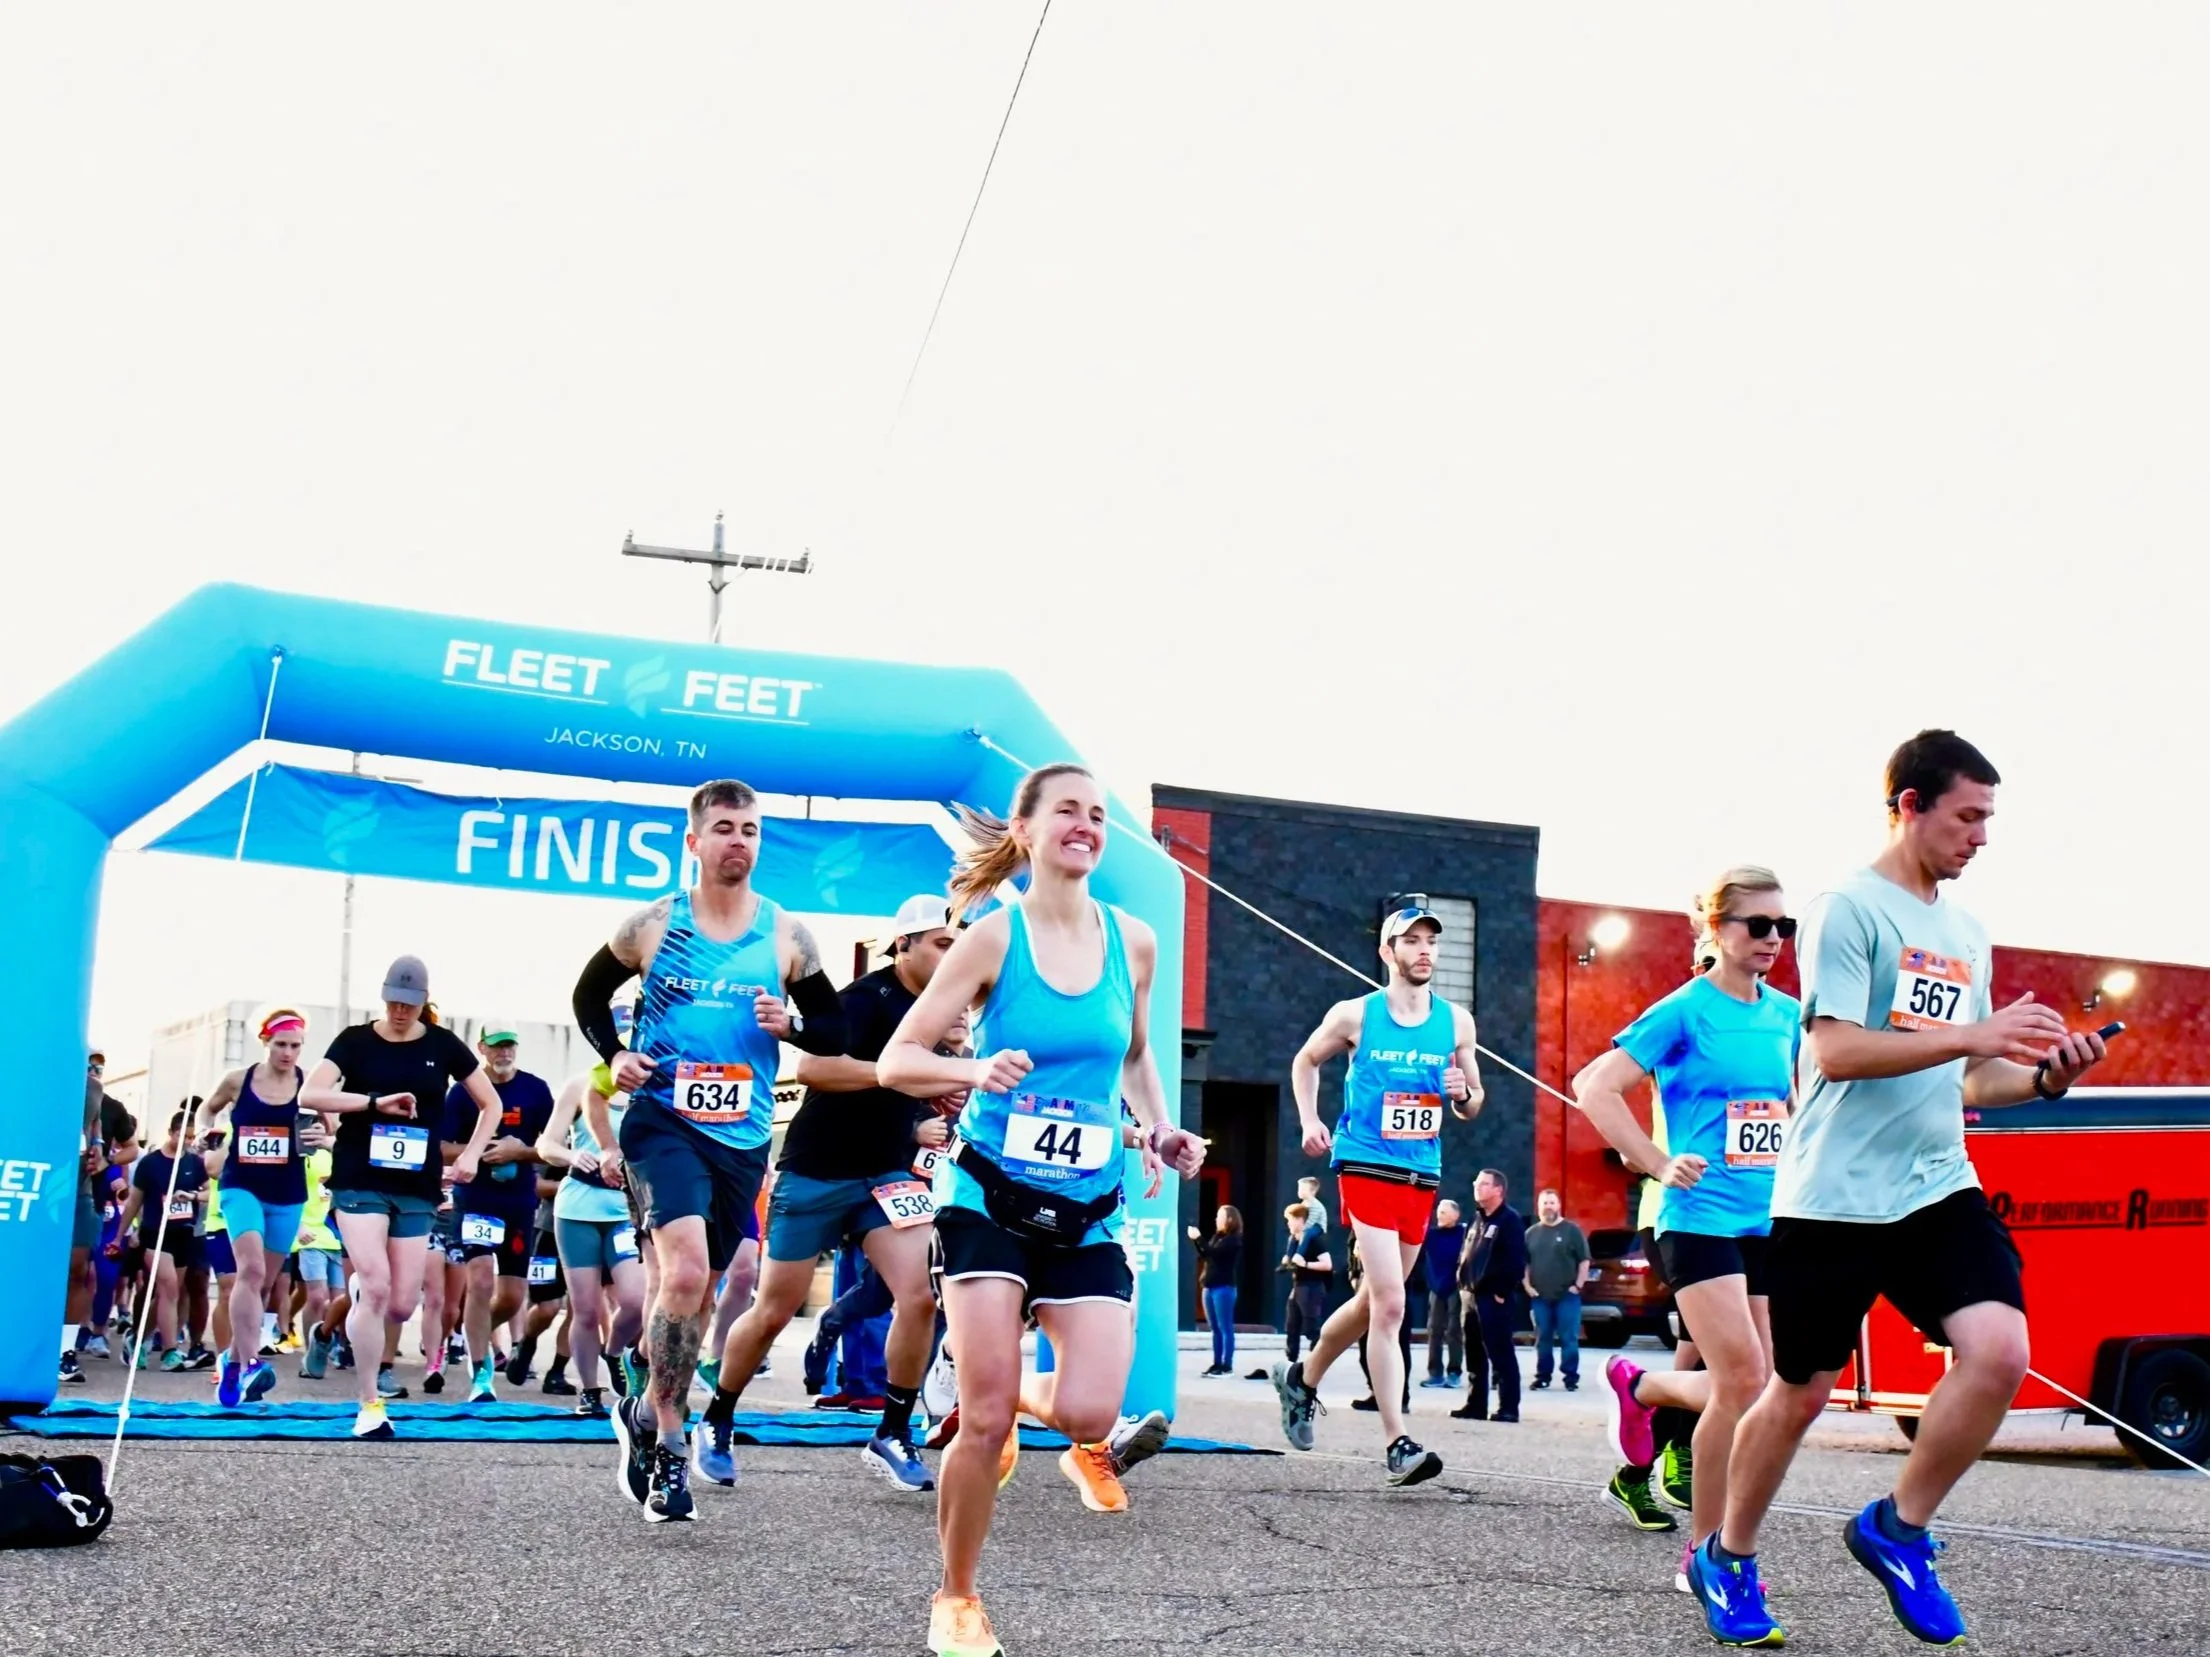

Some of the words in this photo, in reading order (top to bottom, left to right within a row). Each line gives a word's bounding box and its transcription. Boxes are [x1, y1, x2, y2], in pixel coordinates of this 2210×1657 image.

[443, 639, 611, 696] FLEET
[682, 670, 813, 718] FEET
[544, 727, 665, 757] JACKSON,
[675, 740, 707, 759] TN
[665, 976, 710, 991] FLEET
[728, 983, 757, 997] FEE
[1910, 978, 1961, 1020] 567
[1370, 1049, 1405, 1062] FLEET
[1420, 1053, 1446, 1066] FEET
[687, 1083, 739, 1111] 634
[1392, 1109, 1433, 1131] 518
[247, 1139, 280, 1156] 644
[1034, 1123, 1082, 1165] 44
[1739, 1123, 1783, 1153] 626
[392, 1140, 405, 1160] 9
[923, 1152, 942, 1169] 6
[0, 1158, 52, 1192] ET
[1025, 1166, 1080, 1180] marathon
[891, 1194, 934, 1217] 538
[474, 1224, 492, 1240] 34
[532, 1266, 545, 1279] 41
